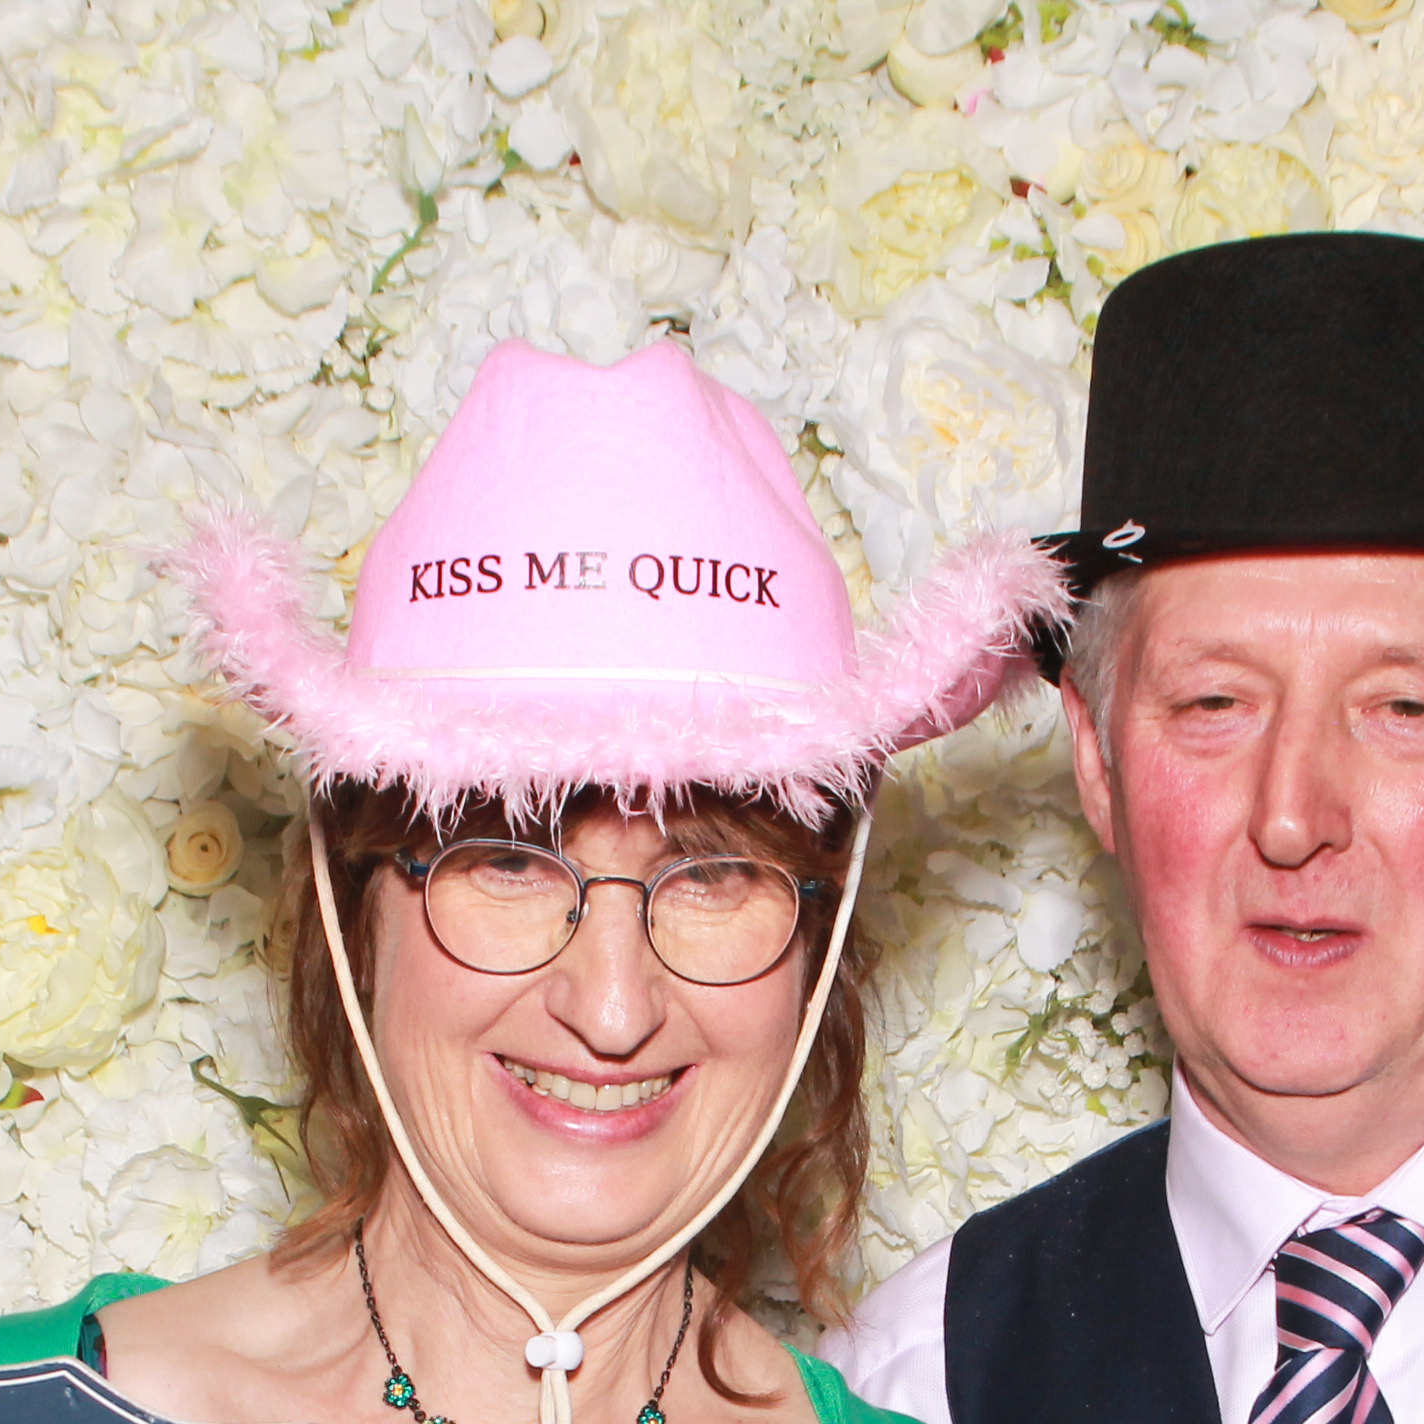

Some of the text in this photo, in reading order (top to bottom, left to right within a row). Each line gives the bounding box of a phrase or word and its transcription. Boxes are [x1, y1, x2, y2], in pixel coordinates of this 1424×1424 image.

[410, 552, 780, 608] KISS ME QUICK
